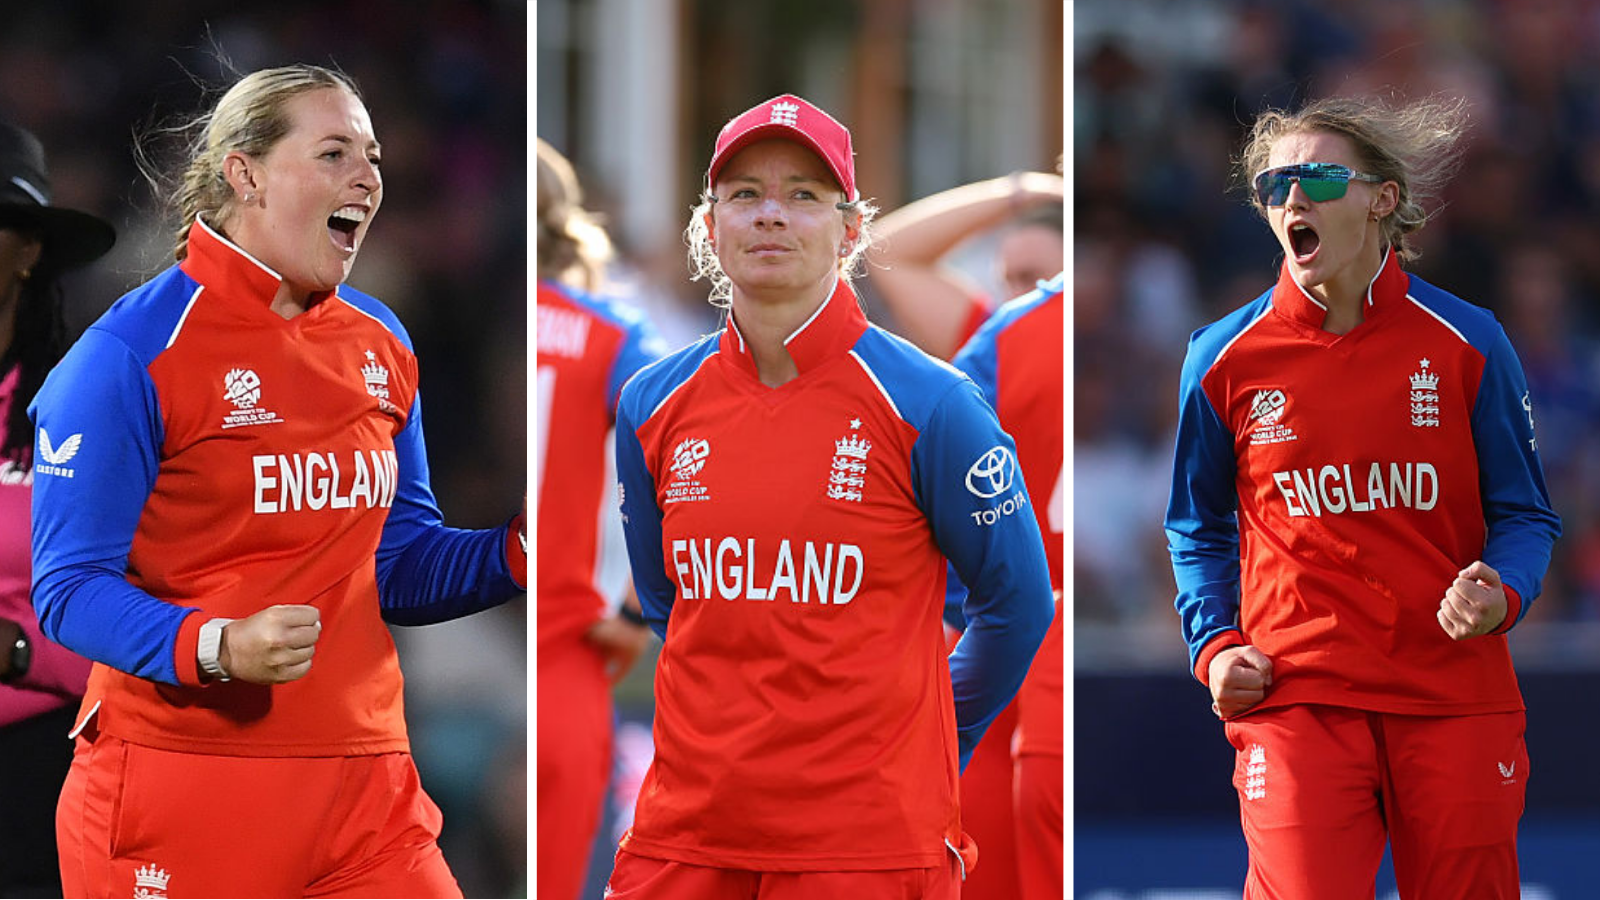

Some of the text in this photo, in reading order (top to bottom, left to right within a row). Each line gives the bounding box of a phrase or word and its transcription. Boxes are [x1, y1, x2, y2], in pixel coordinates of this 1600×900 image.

[223, 414, 257, 424] WORLD
[258, 412, 276, 420] CUP
[1250, 428, 1293, 439] WORLD CUP
[690, 487, 708, 495] CUP
[1272, 462, 1438, 517] ENGLAND
[970, 490, 1026, 526] TOYOTA
[672, 536, 864, 606] ENGLAND
